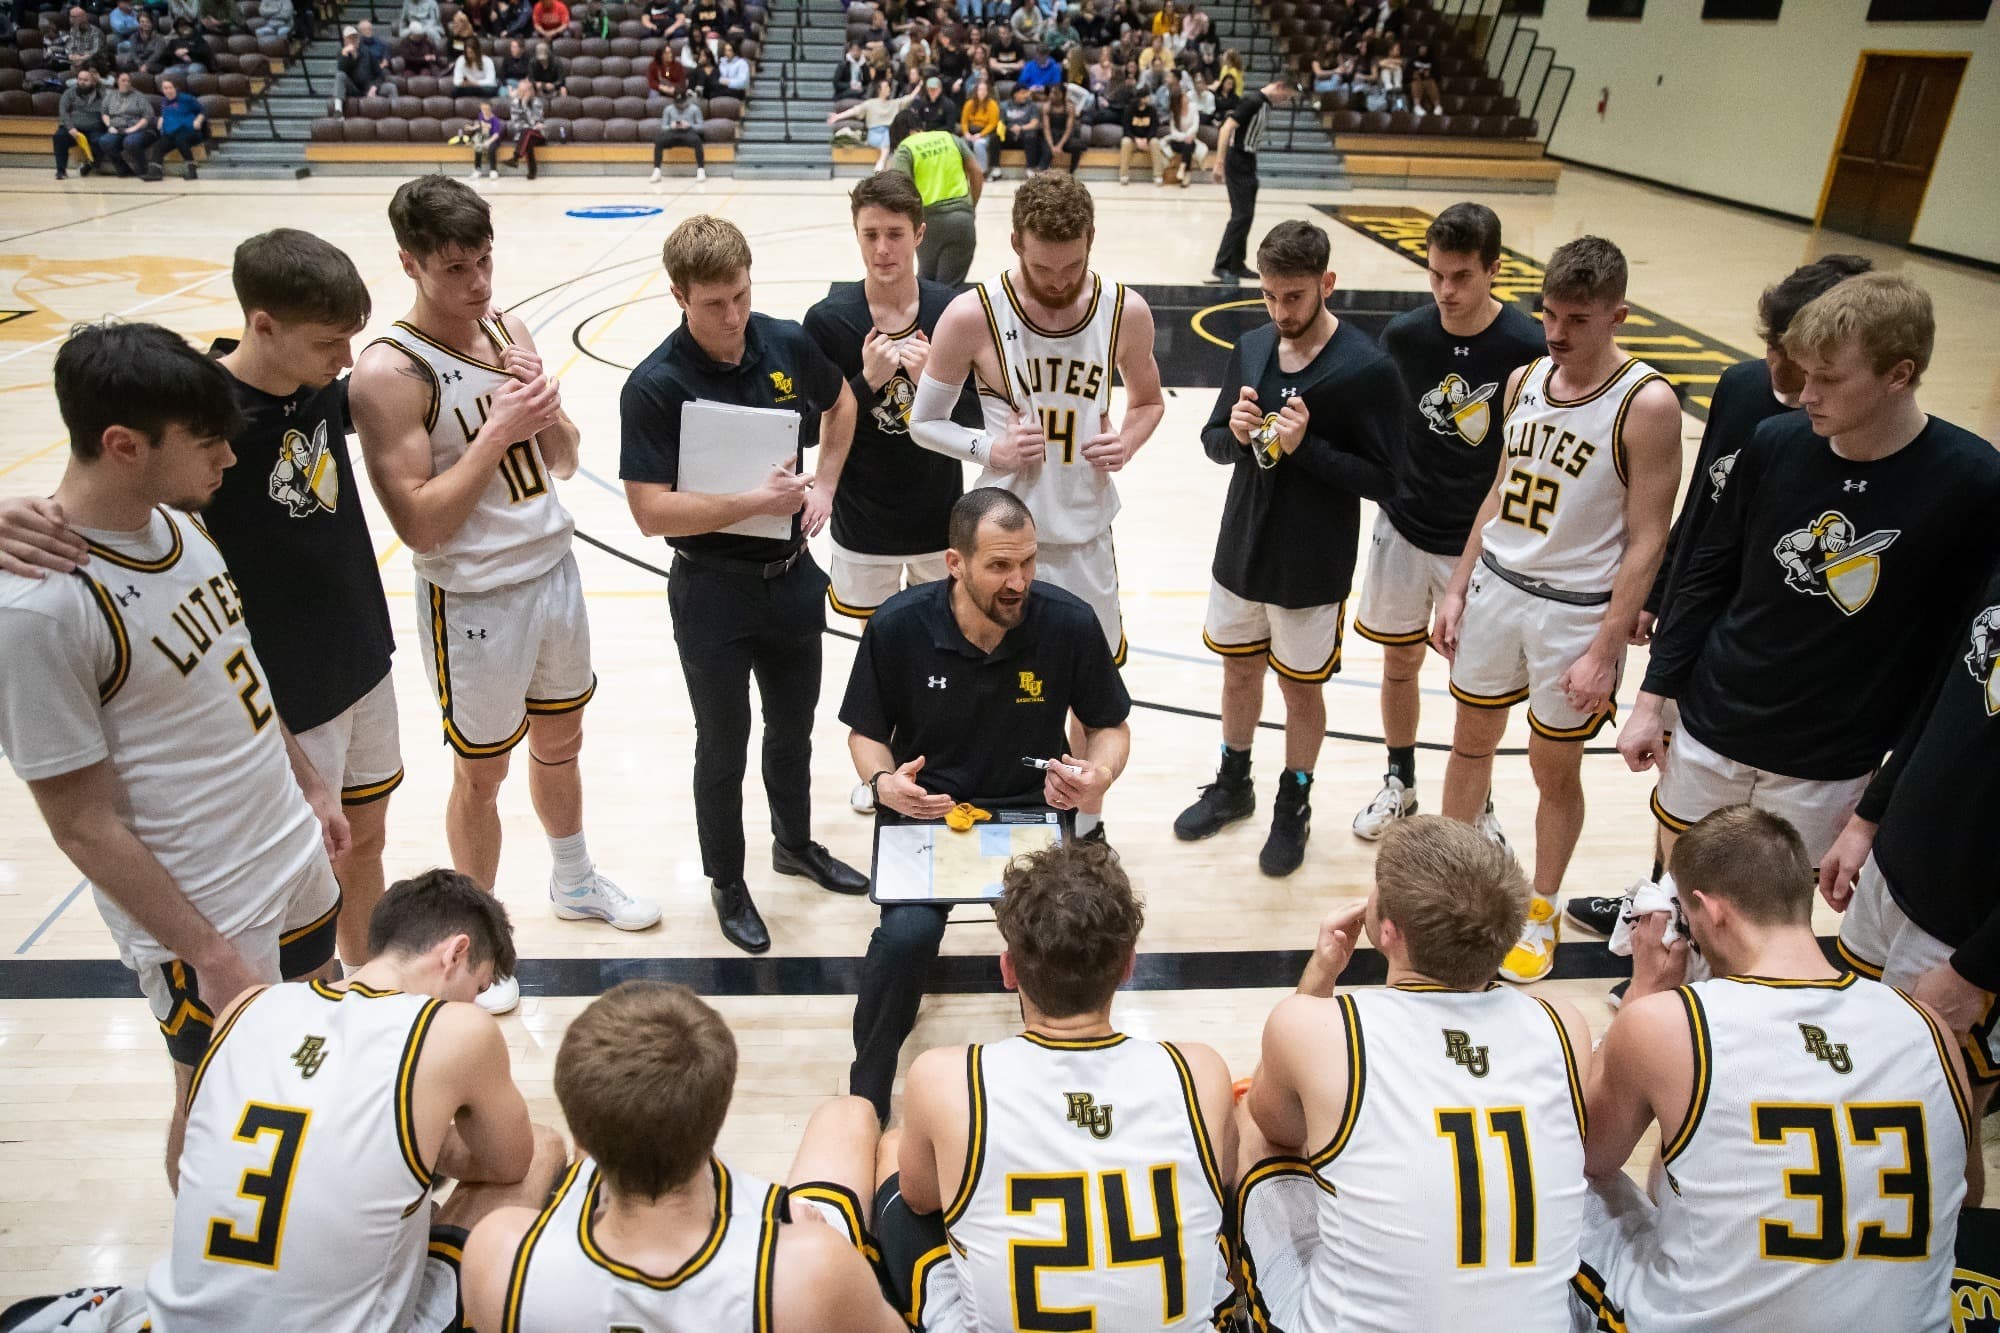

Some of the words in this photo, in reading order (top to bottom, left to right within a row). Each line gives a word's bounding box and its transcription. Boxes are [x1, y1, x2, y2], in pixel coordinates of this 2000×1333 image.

[1507, 422, 1597, 478] LUTES
[1501, 468, 1560, 536] 22
[224, 646, 273, 735] 2
[1442, 1028, 1489, 1078] PLU
[1062, 1092, 1113, 1140] PLU
[203, 1100, 313, 1271] 3
[1433, 1105, 1536, 1268] 11
[1750, 1102, 1933, 1264] 33
[1006, 1163, 1186, 1333] 24
